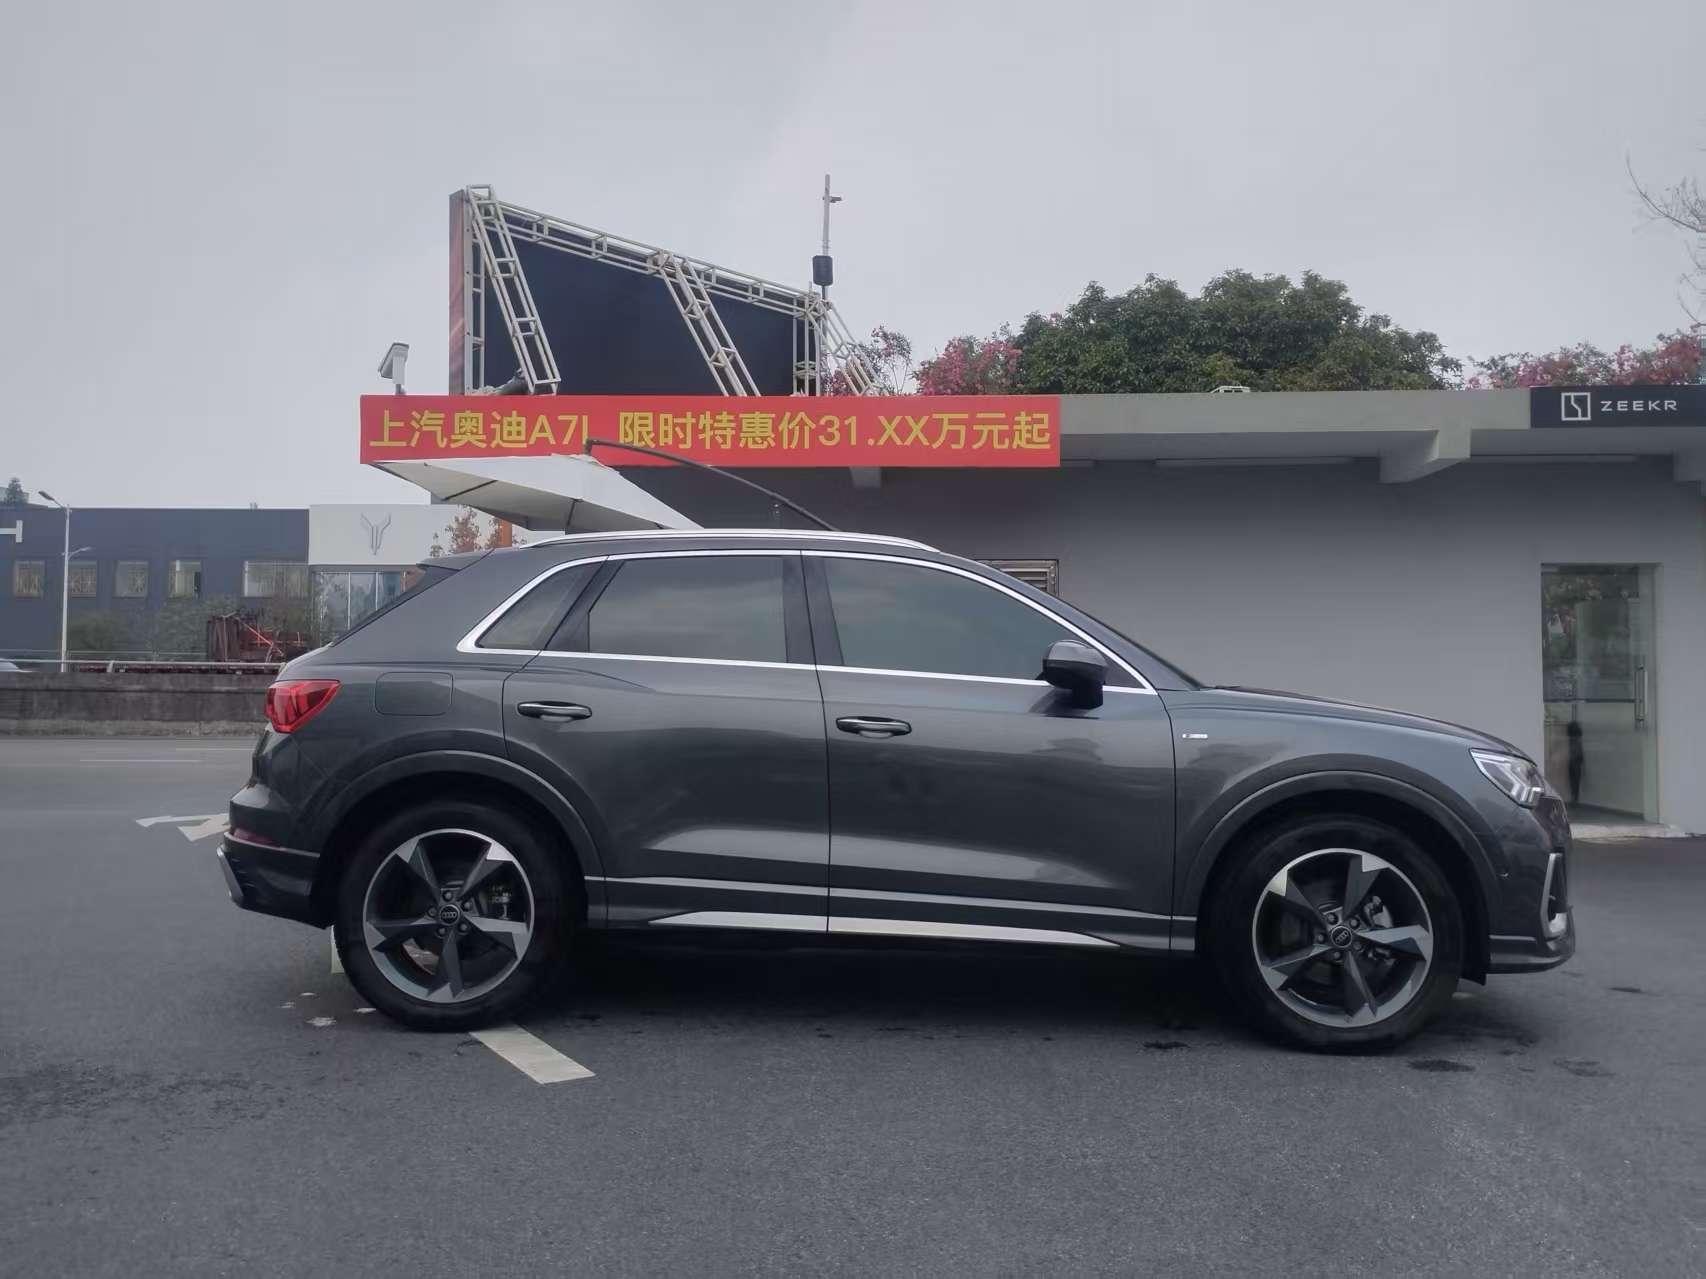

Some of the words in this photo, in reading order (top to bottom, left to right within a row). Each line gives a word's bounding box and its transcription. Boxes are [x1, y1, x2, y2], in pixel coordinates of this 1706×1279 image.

[1600, 400, 1678, 412] ZEEKR
[619, 410, 1051, 450] 限时特惠价31.XX万元起
